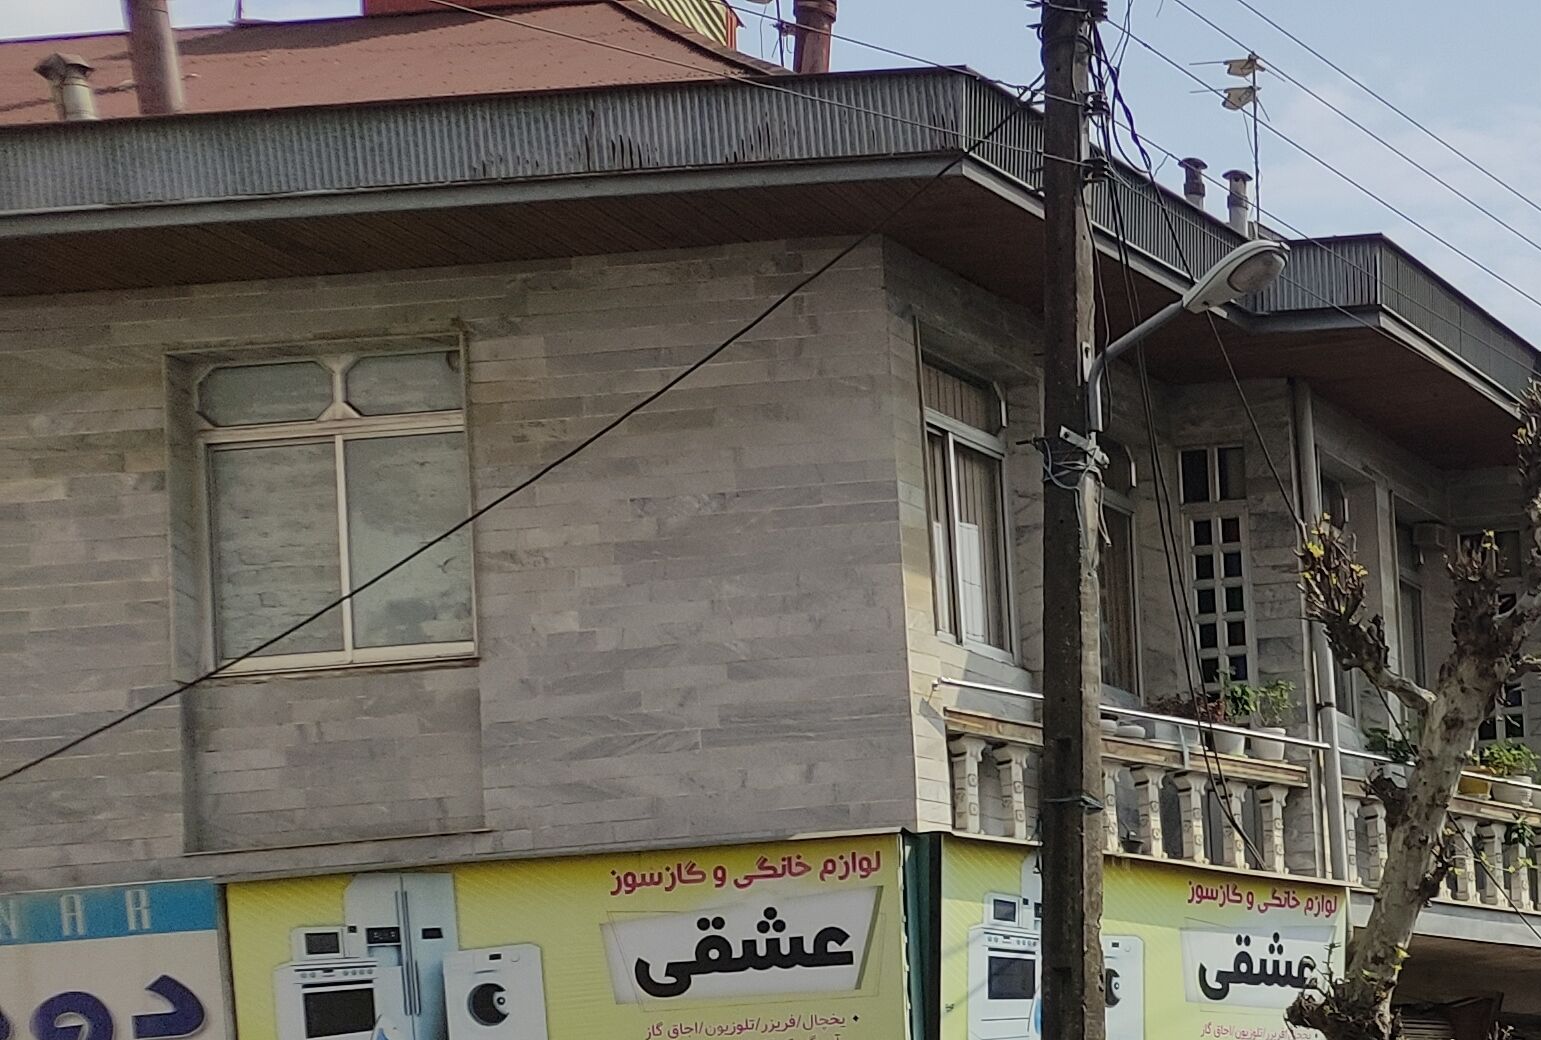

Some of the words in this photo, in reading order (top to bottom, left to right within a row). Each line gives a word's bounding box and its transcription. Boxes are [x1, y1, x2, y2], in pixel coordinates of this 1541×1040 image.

[713, 865, 727, 888] و
[733, 854, 812, 889] خانگی
[819, 850, 881, 882] لوازم
[1246, 891, 1254, 910] و
[1258, 888, 1301, 913] خانگی
[1304, 895, 1337, 917] لوازم
[634, 906, 854, 999] عشقی
[1199, 932, 1322, 1001] عشقی
[645, 1021, 664, 1040] گاز
